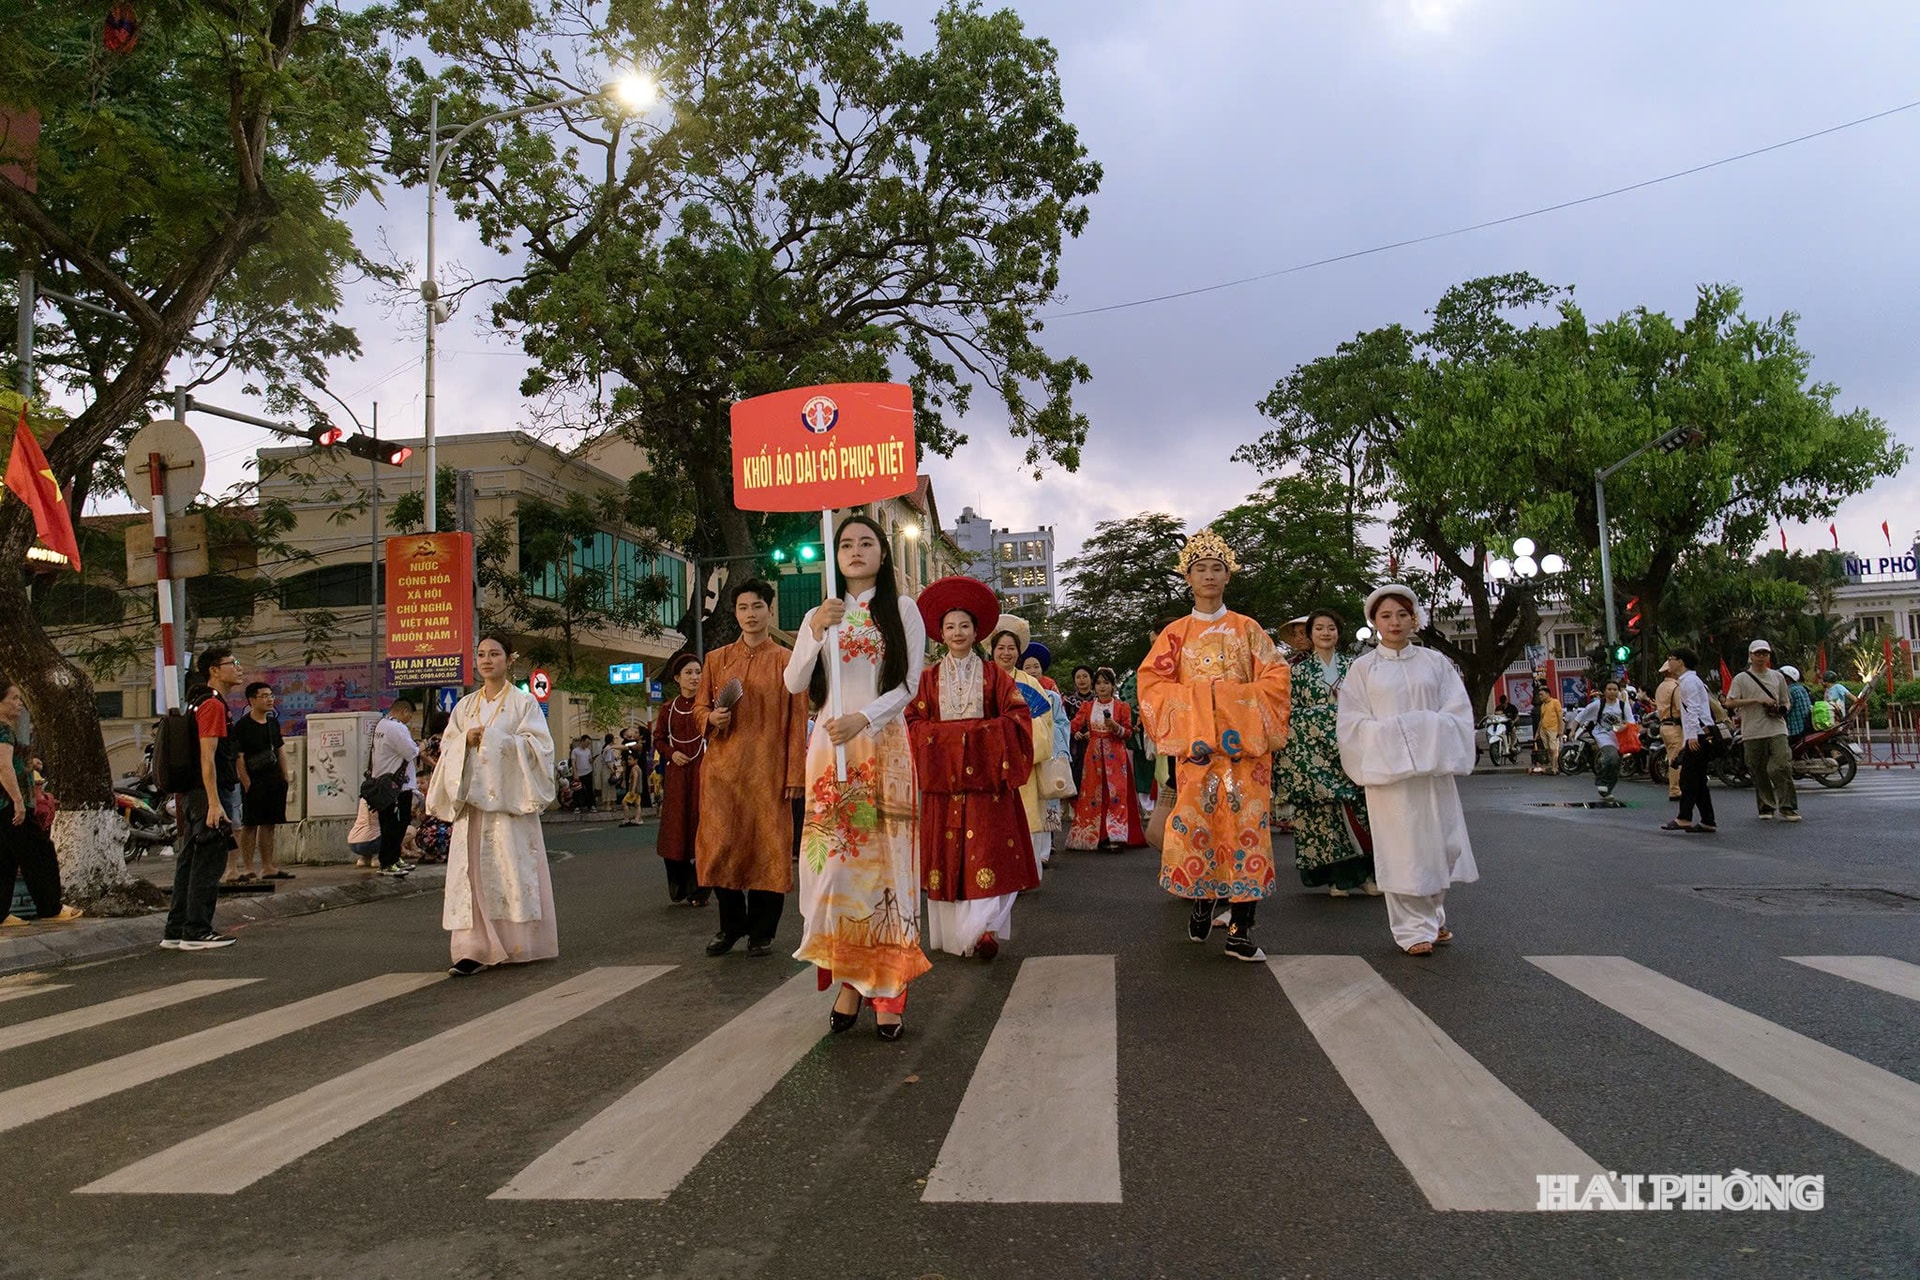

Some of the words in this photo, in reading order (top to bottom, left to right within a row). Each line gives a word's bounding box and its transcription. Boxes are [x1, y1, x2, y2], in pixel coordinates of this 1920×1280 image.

[743, 444, 773, 489] KHỐI
[776, 447, 792, 486] ÁO
[840, 444, 875, 485] PHỤC
[877, 435, 904, 482] VIỆT
[410, 561, 439, 572] NƯỚC
[398, 575, 427, 588] CỘNG
[407, 589, 421, 600] XÃ
[424, 588, 442, 600] HỘI
[396, 602, 418, 614] CHỦ
[420, 601, 453, 613] NGHĨA
[400, 617, 423, 629] VIỆT
[425, 616, 449, 626] NAM
[391, 631, 423, 642] MUÔN
[426, 629, 450, 640] NĂM
[390, 658, 408, 669] TÂN
[410, 659, 424, 669] AN
[425, 657, 460, 668] PALACE
